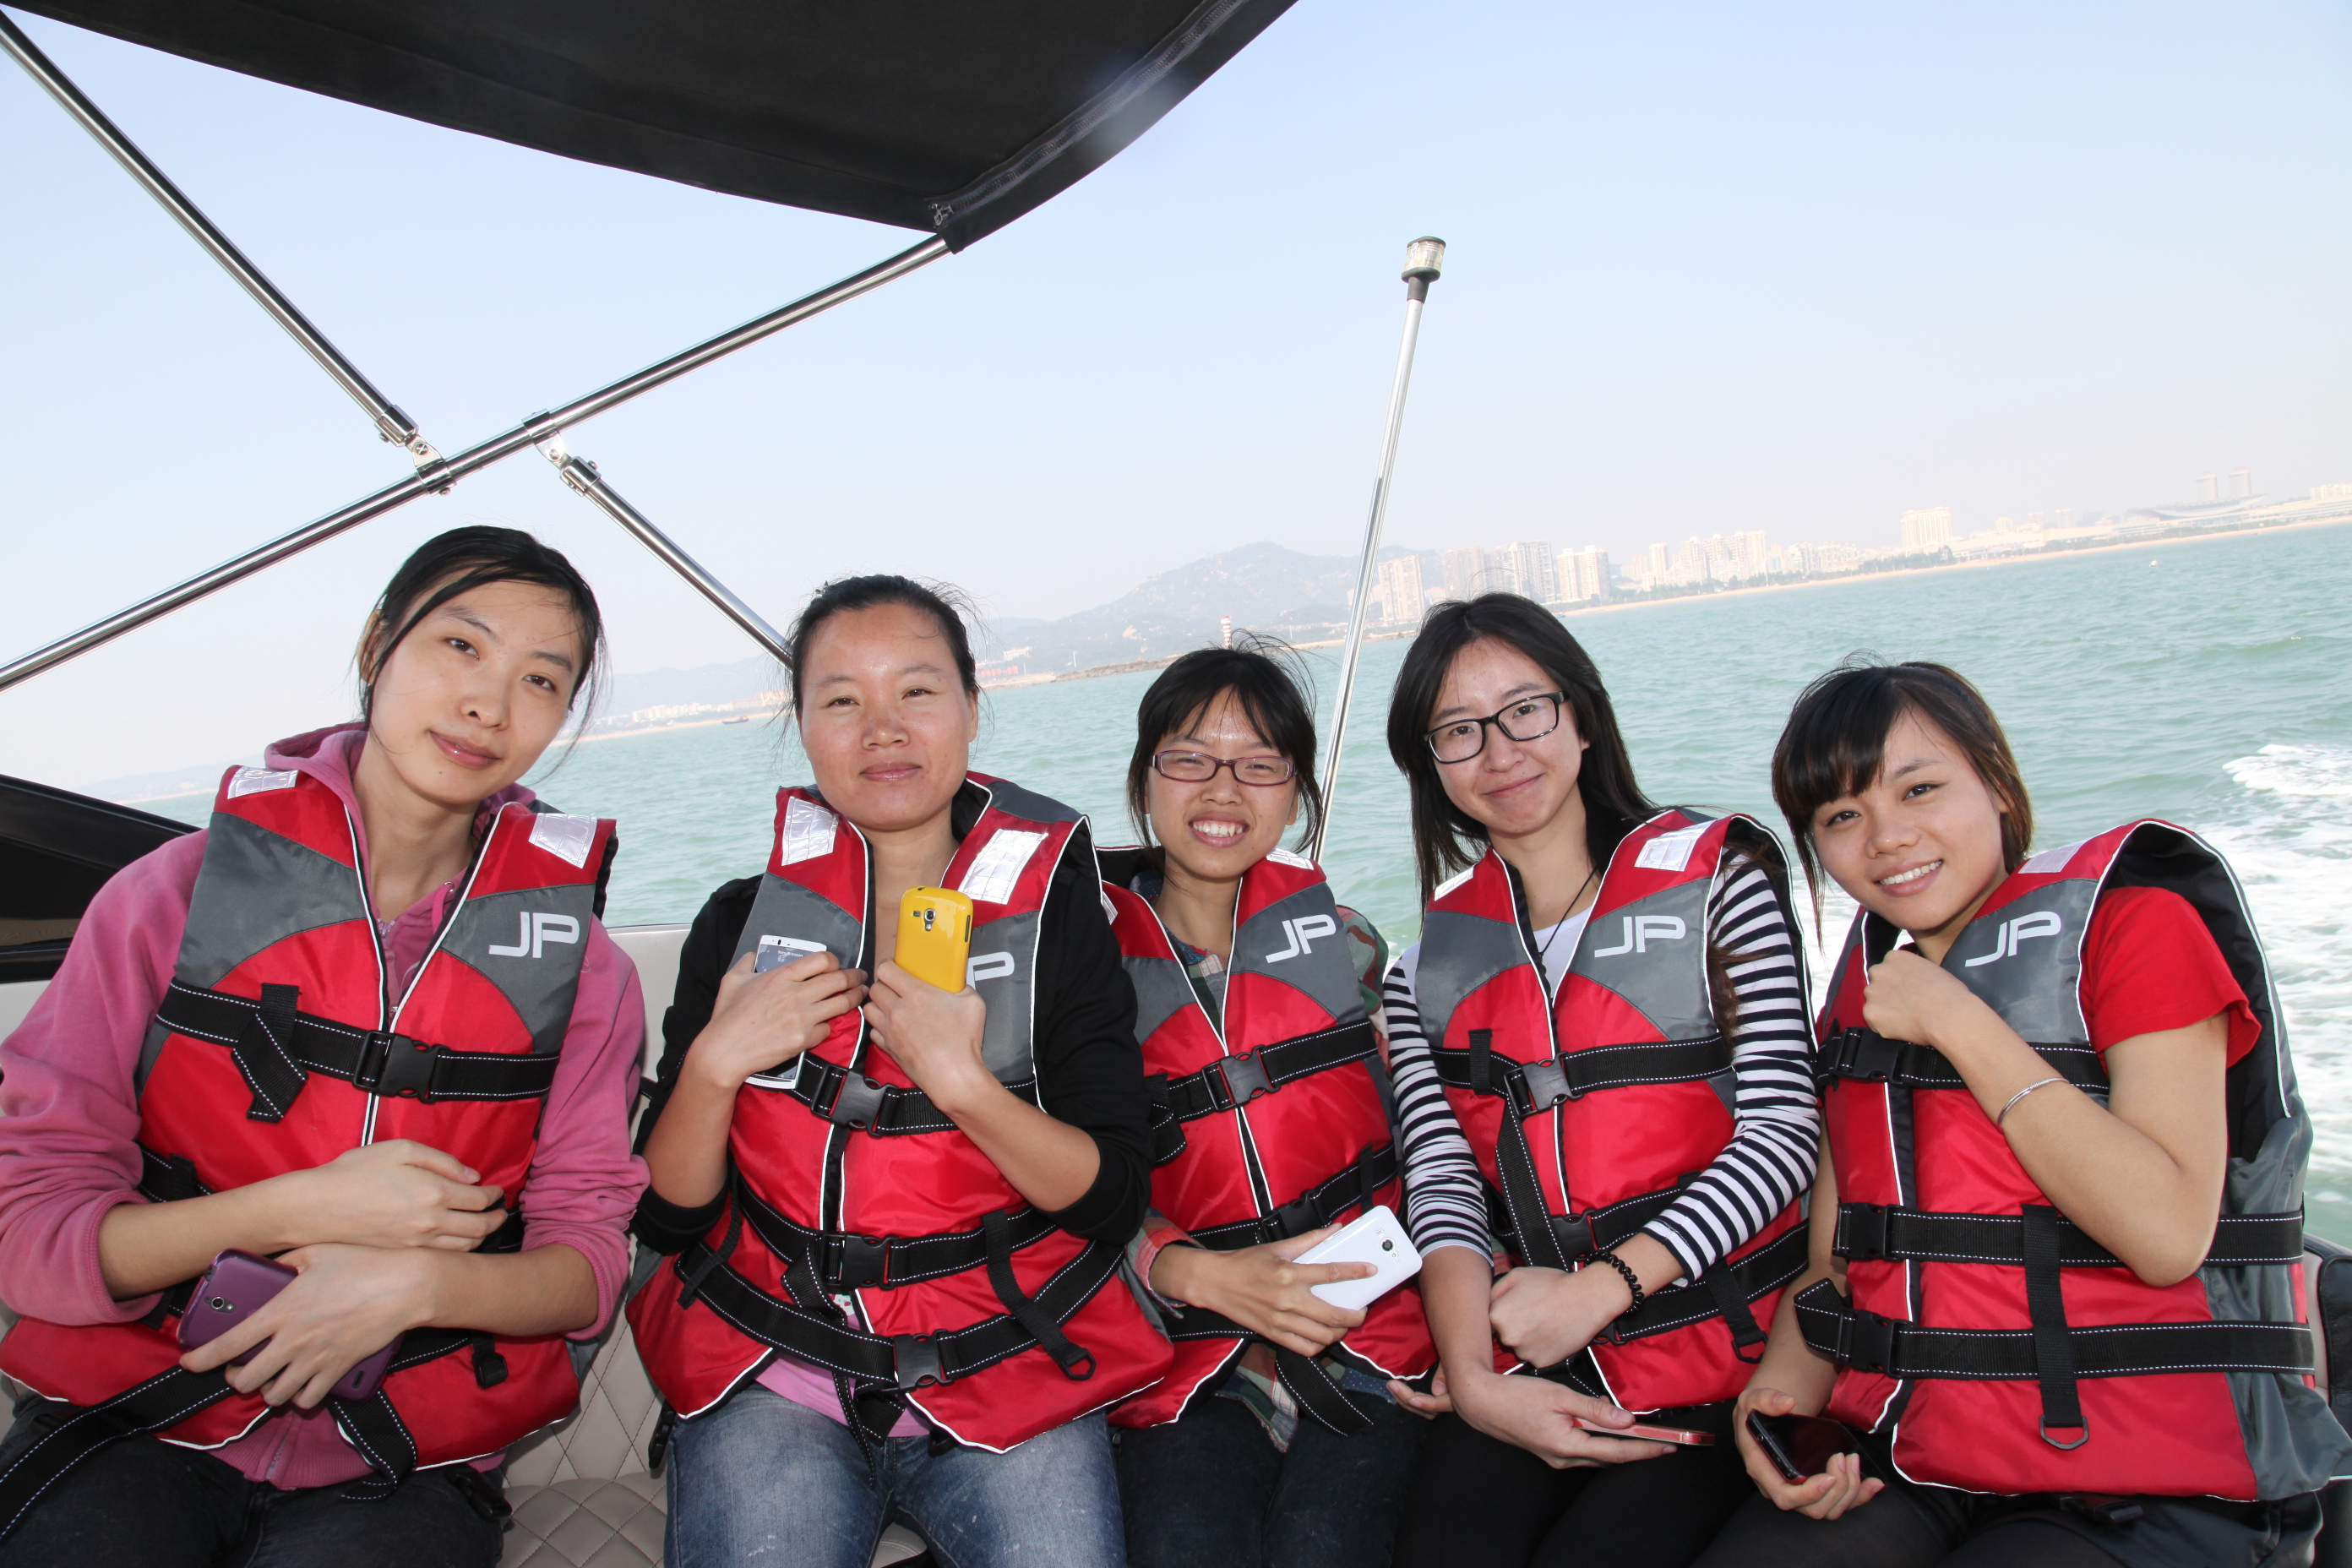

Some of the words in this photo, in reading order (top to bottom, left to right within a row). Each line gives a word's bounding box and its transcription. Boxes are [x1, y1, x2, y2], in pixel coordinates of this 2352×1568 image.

[488, 912, 580, 959] JP
[1266, 914, 1337, 963] JP
[1594, 915, 1686, 958] JP
[1964, 911, 2061, 967] JP
